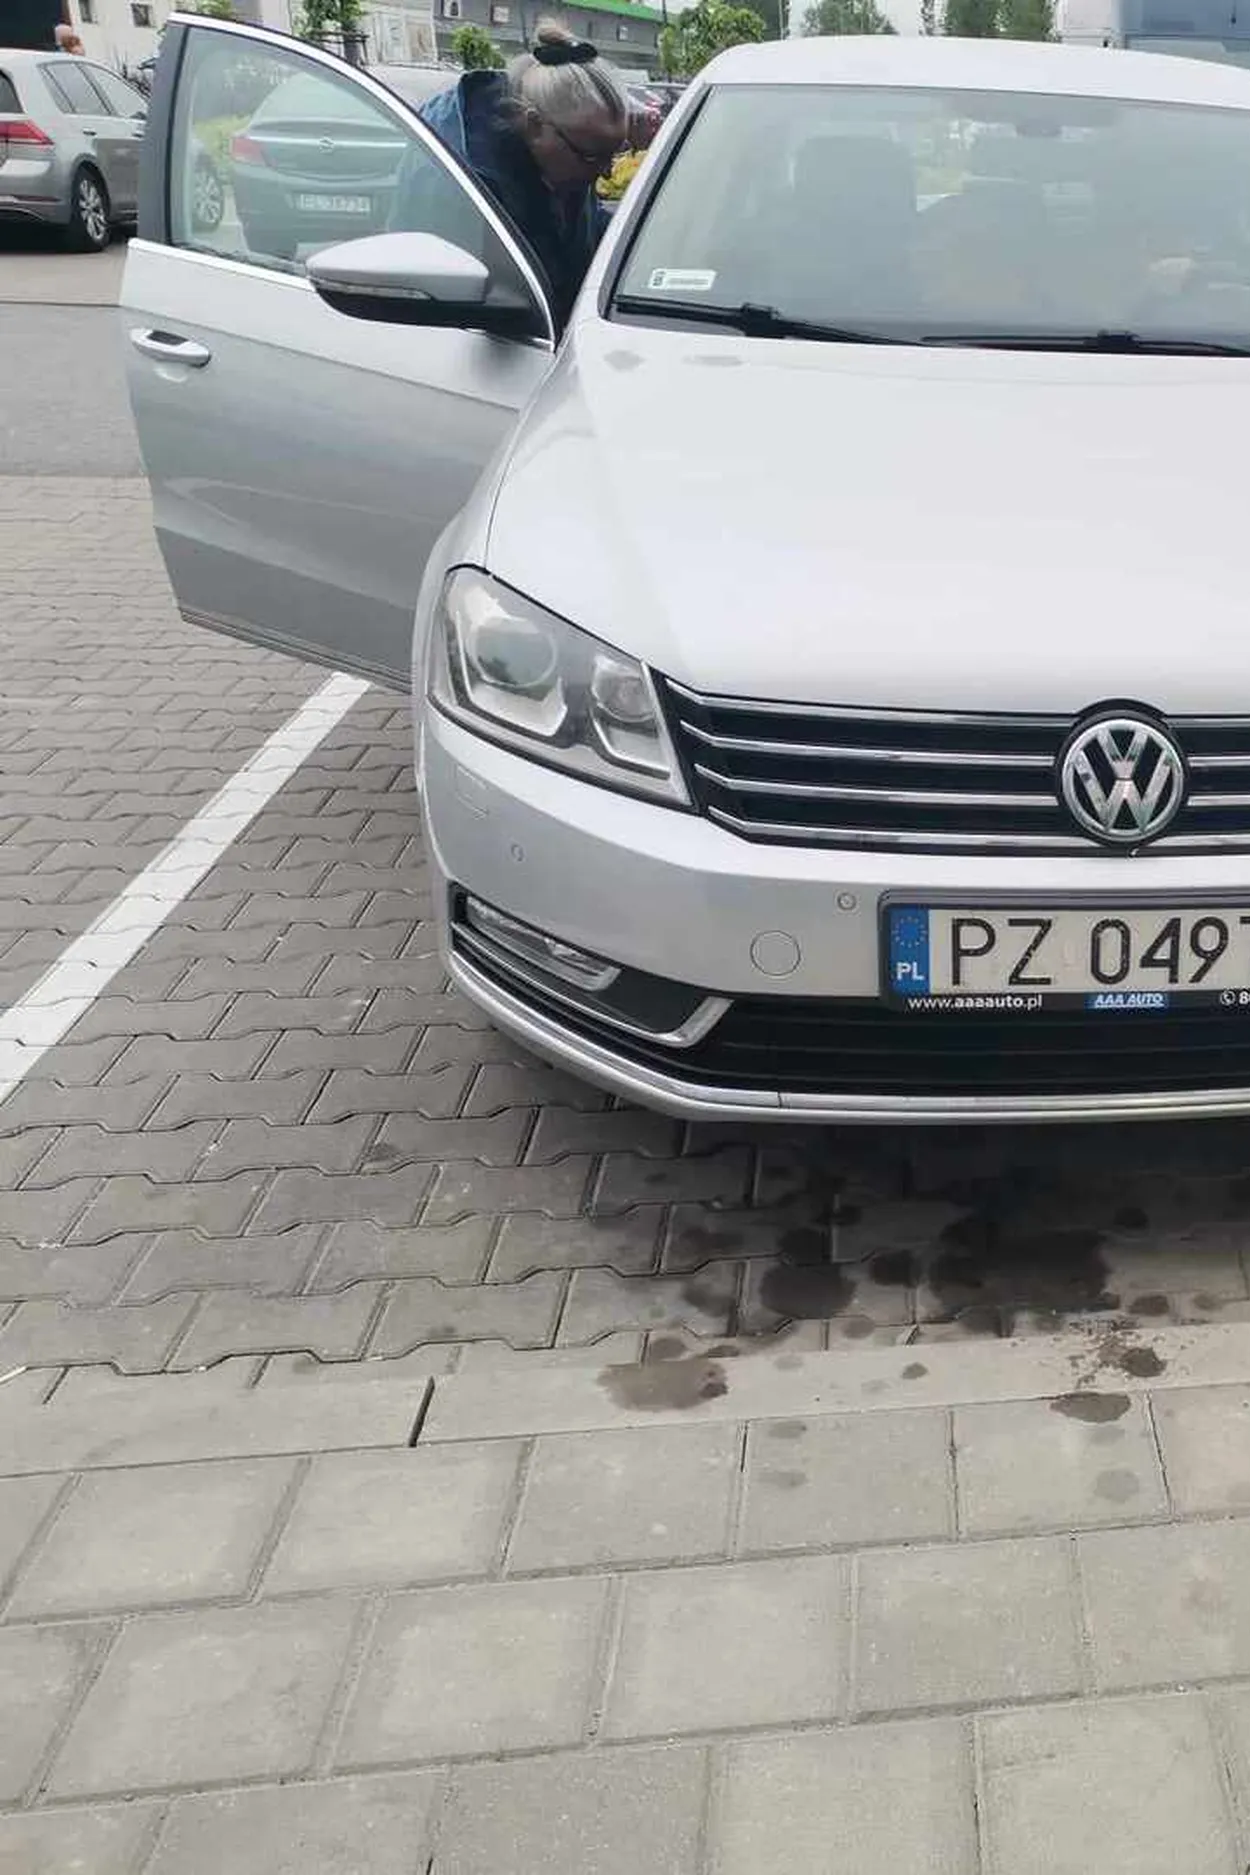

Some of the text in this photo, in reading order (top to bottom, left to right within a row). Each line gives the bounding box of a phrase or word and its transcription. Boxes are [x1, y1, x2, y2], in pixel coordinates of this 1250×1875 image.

[952, 918, 1053, 985] PZ
[896, 961, 925, 981] PL
[908, 994, 1043, 1010] www.aaaauto.pl
[1094, 991, 1165, 1008] AAA AUTO
